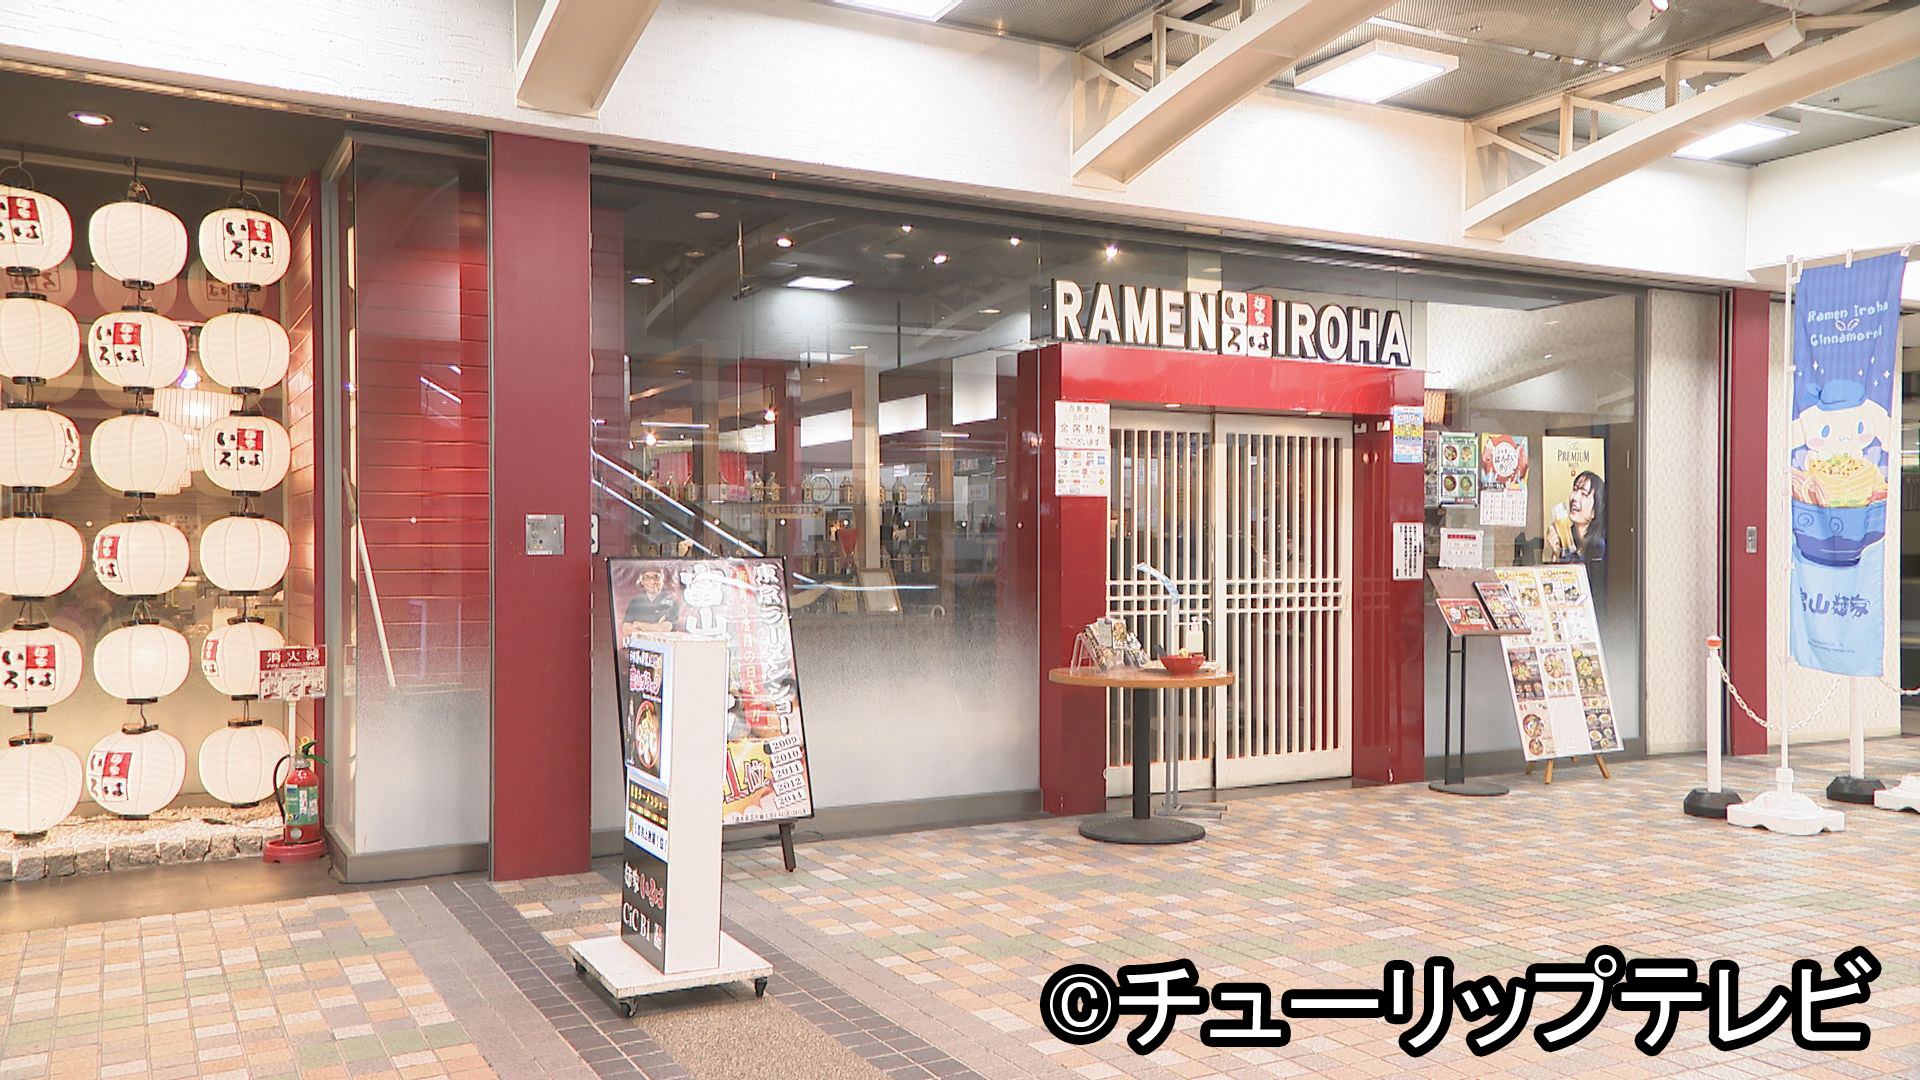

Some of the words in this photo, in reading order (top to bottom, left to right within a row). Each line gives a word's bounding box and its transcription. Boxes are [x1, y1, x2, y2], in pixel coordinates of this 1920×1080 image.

[1807, 309, 1848, 323] Ramen
[1853, 300, 1889, 317] Iroha
[1053, 279, 1218, 351] RAMEN
[1277, 300, 1412, 367] IROHA
[1557, 449, 1590, 463] PREMIUM
[267, 650, 319, 664] 消火器
[772, 736, 798, 750] 2009
[774, 749, 799, 763] 2010
[775, 763, 800, 777] 2011
[777, 777, 802, 791] 2012
[778, 791, 803, 804] 2014
[623, 902, 639, 931] CiC
